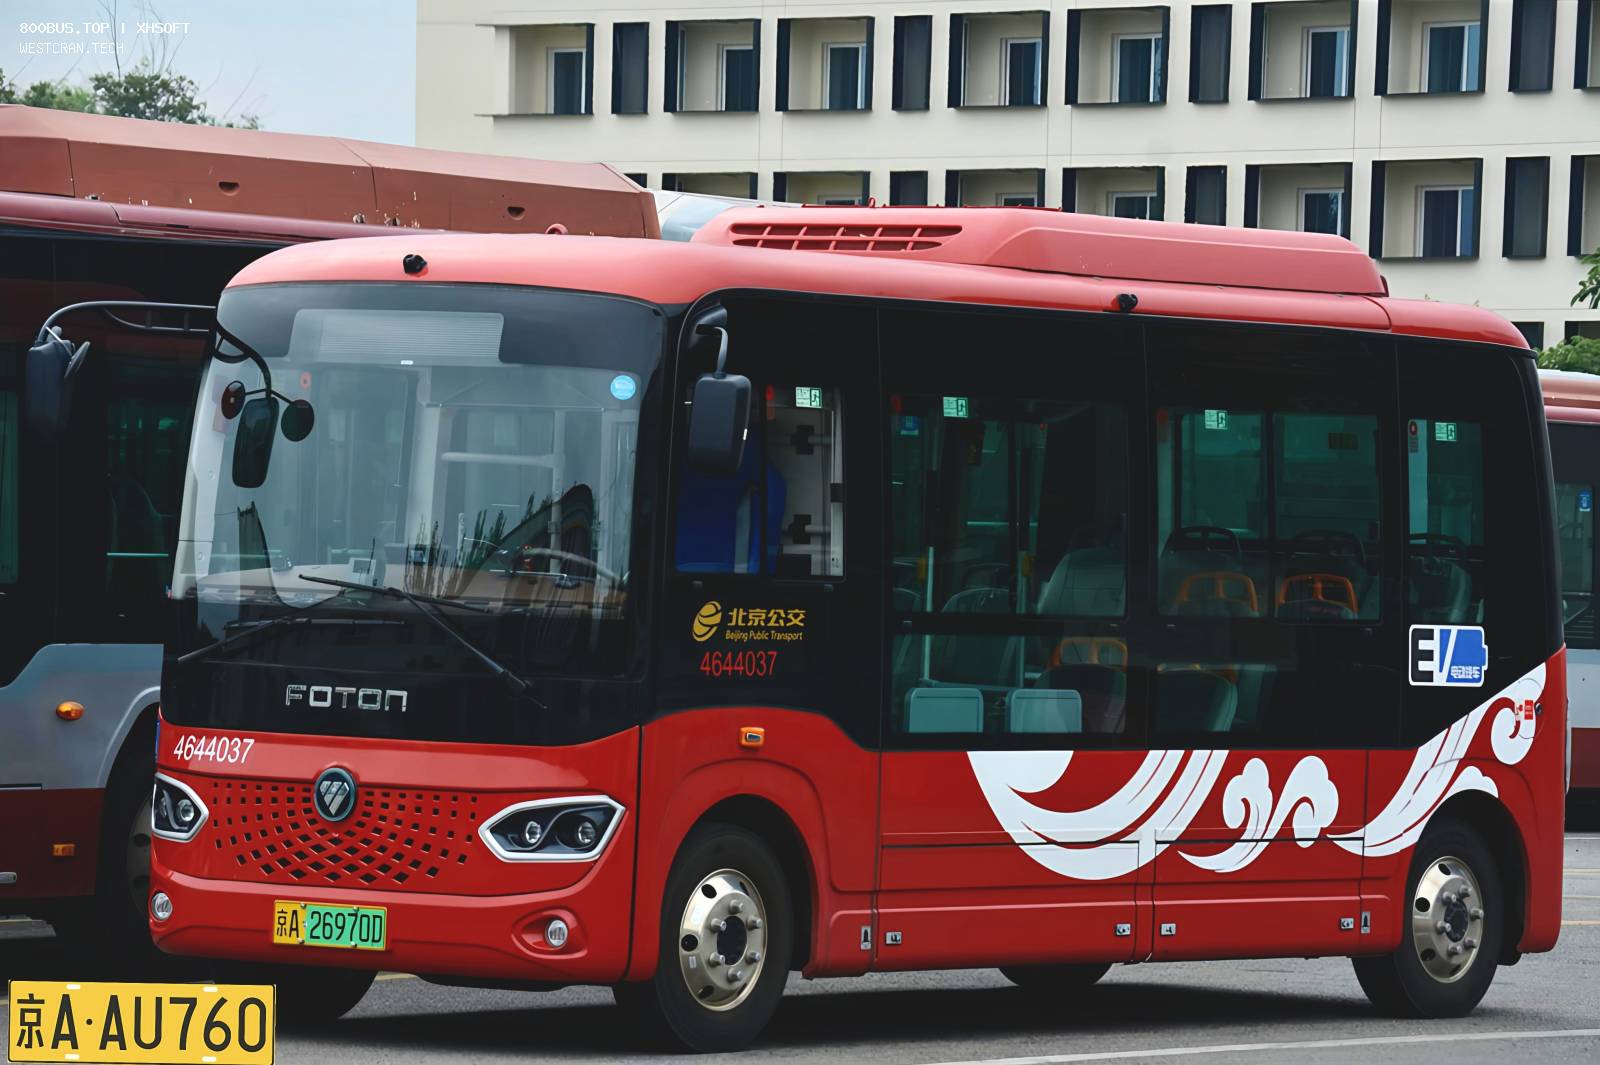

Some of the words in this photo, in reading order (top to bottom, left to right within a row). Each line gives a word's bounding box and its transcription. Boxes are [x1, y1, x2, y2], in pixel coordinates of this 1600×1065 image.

[727, 608, 806, 627] 北京公交
[725, 630, 748, 642] Beijing
[749, 630, 769, 640] Public
[771, 630, 803, 642] Transport
[700, 650, 777, 676] 4644037
[285, 684, 408, 712] FOTON
[173, 735, 255, 764] 4644037
